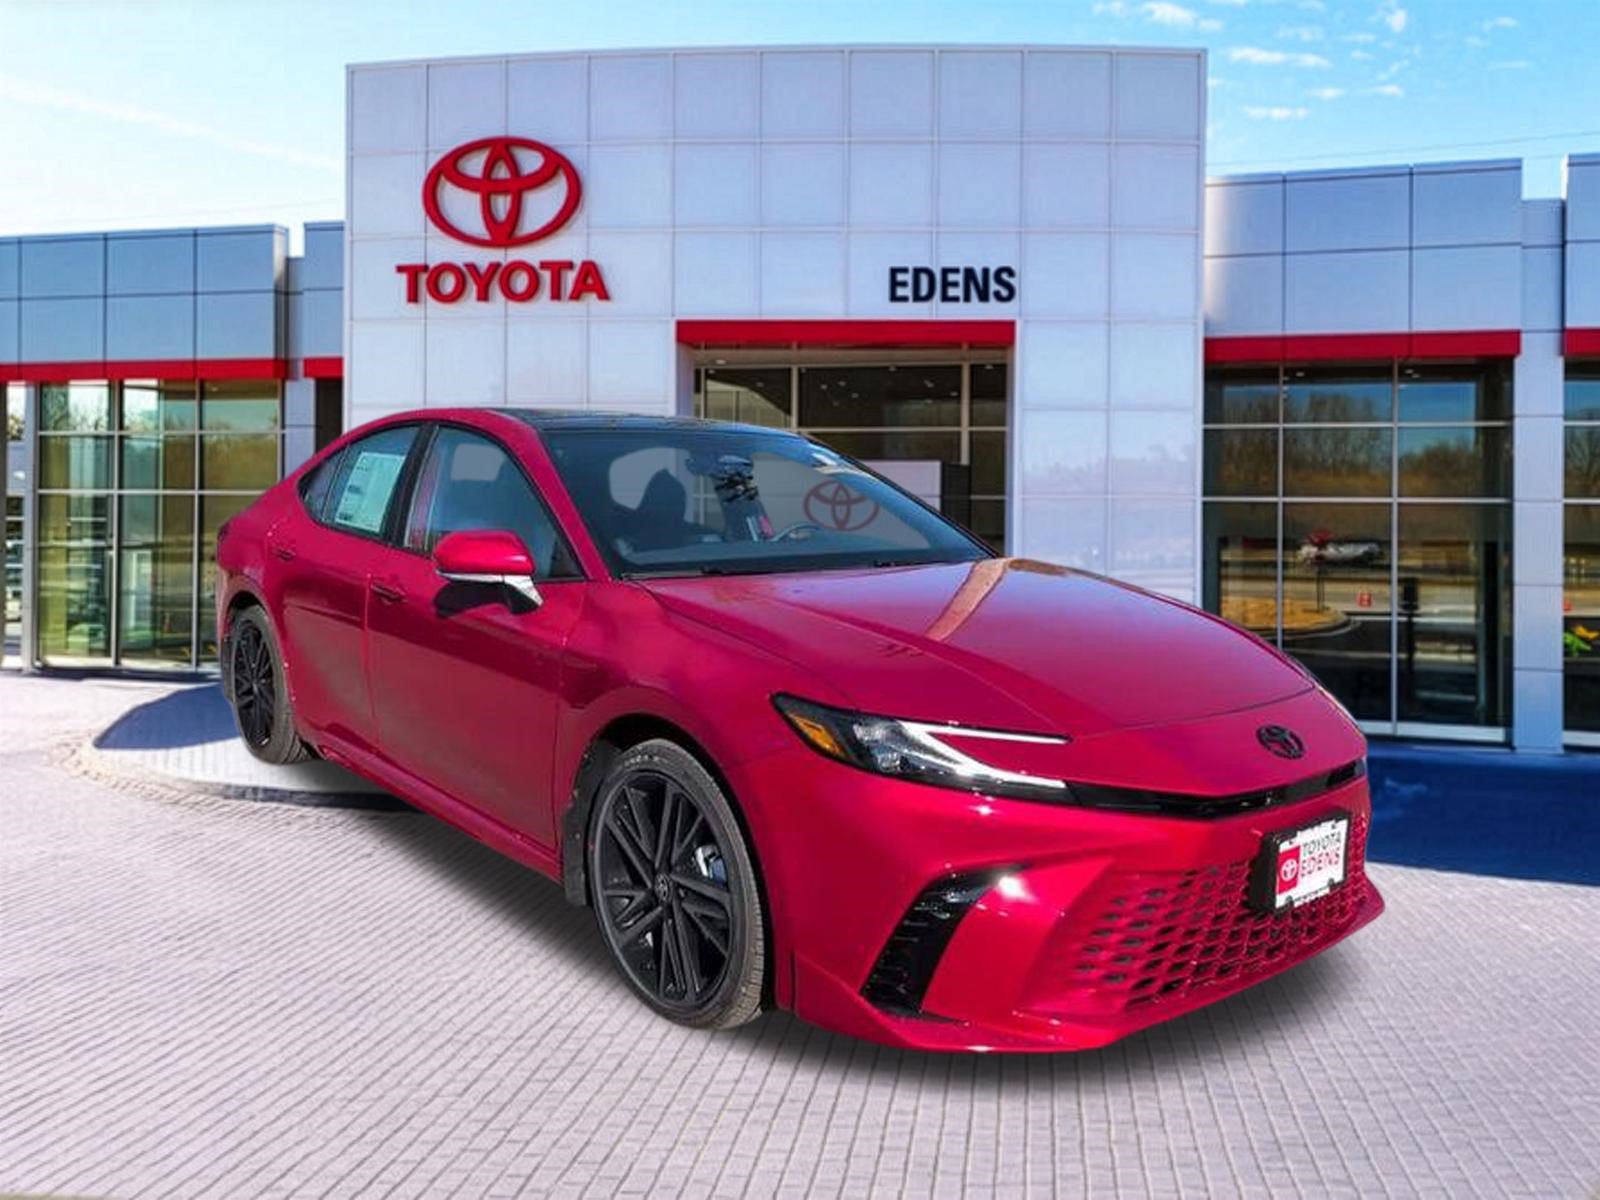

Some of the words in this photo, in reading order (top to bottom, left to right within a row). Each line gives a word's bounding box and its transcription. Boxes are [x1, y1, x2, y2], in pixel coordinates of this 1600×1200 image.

[396, 261, 610, 304] TOYOTA
[889, 266, 1016, 303] EDENS
[1302, 831, 1341, 857] TOYOTA
[1301, 847, 1340, 877] EDENS
